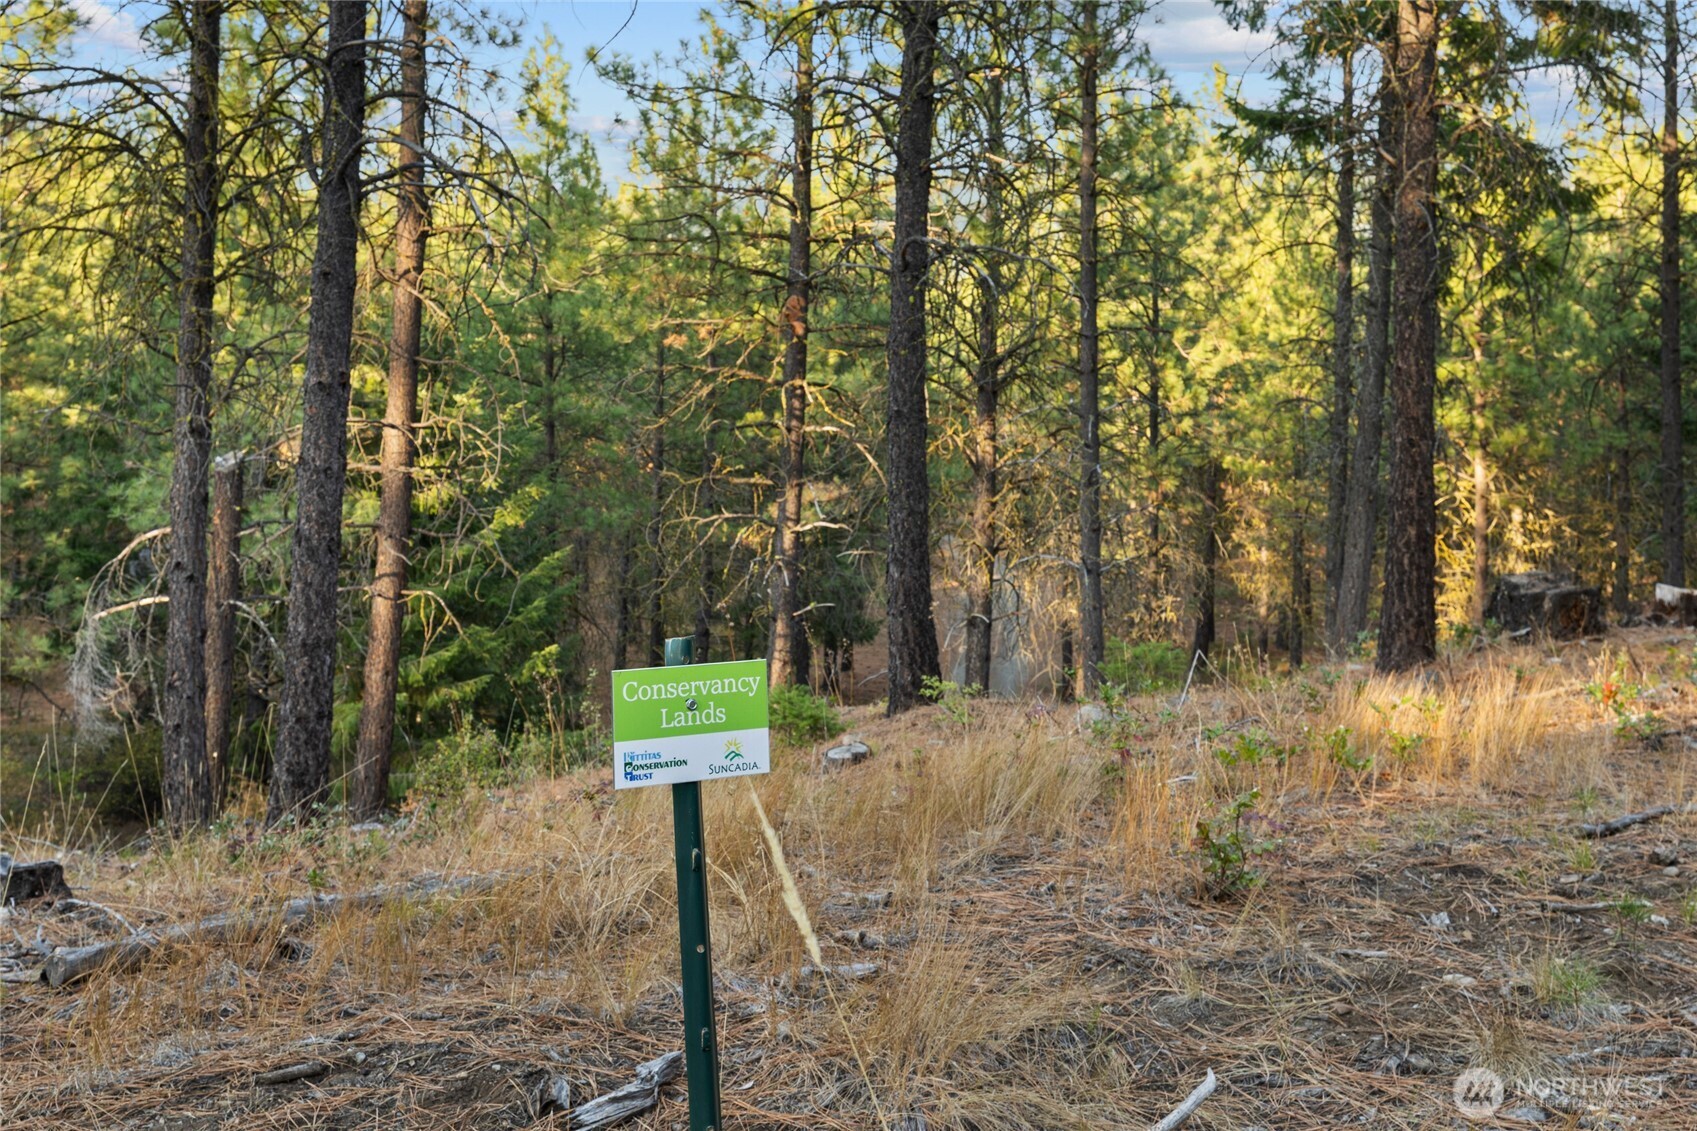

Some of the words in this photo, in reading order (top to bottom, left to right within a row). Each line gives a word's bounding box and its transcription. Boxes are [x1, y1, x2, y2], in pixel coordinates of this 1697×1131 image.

[622, 676, 760, 701] Conservancy
[660, 702, 726, 728] Lands
[624, 757, 688, 773] CONSERVATION
[624, 771, 653, 781] TRUST
